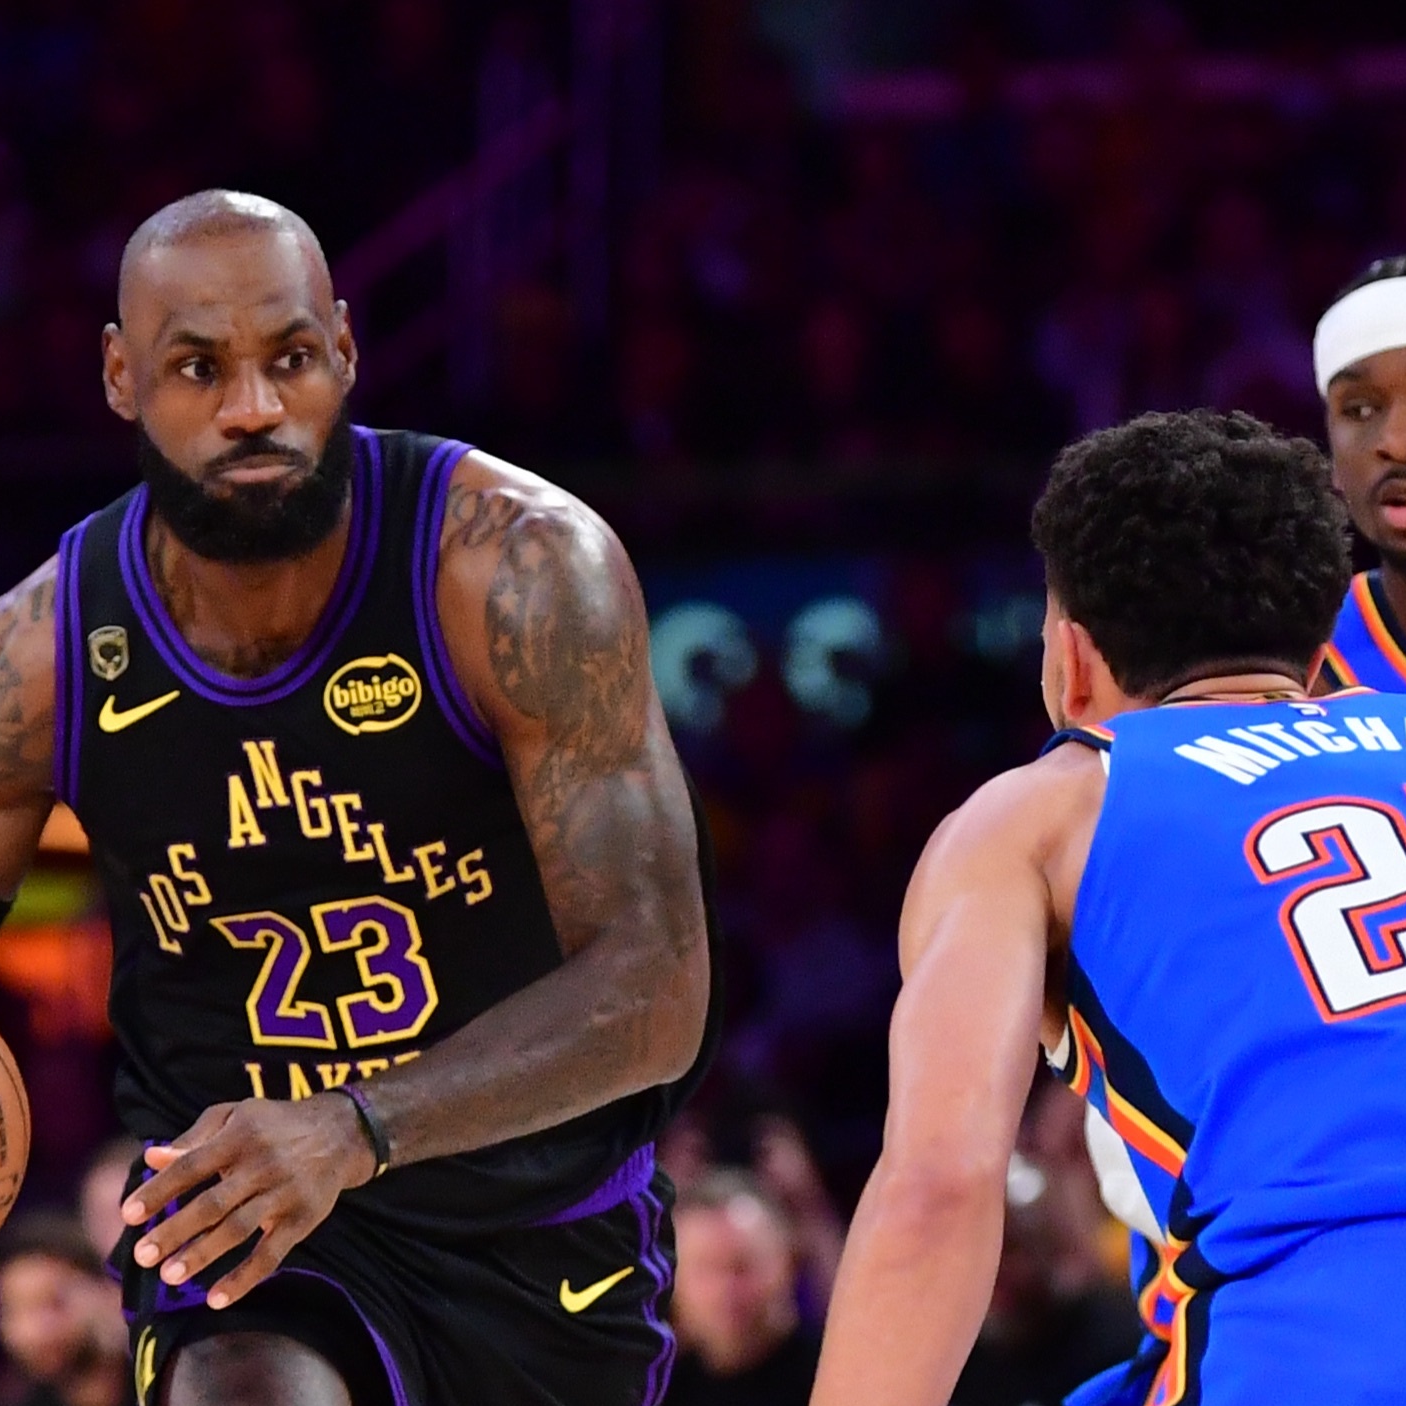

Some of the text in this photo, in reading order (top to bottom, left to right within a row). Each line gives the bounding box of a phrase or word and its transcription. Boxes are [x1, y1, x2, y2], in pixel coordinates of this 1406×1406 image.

[333, 675, 415, 709] bibigo
[139, 740, 494, 955] LOS ANGELES
[209, 895, 440, 1050] 23
